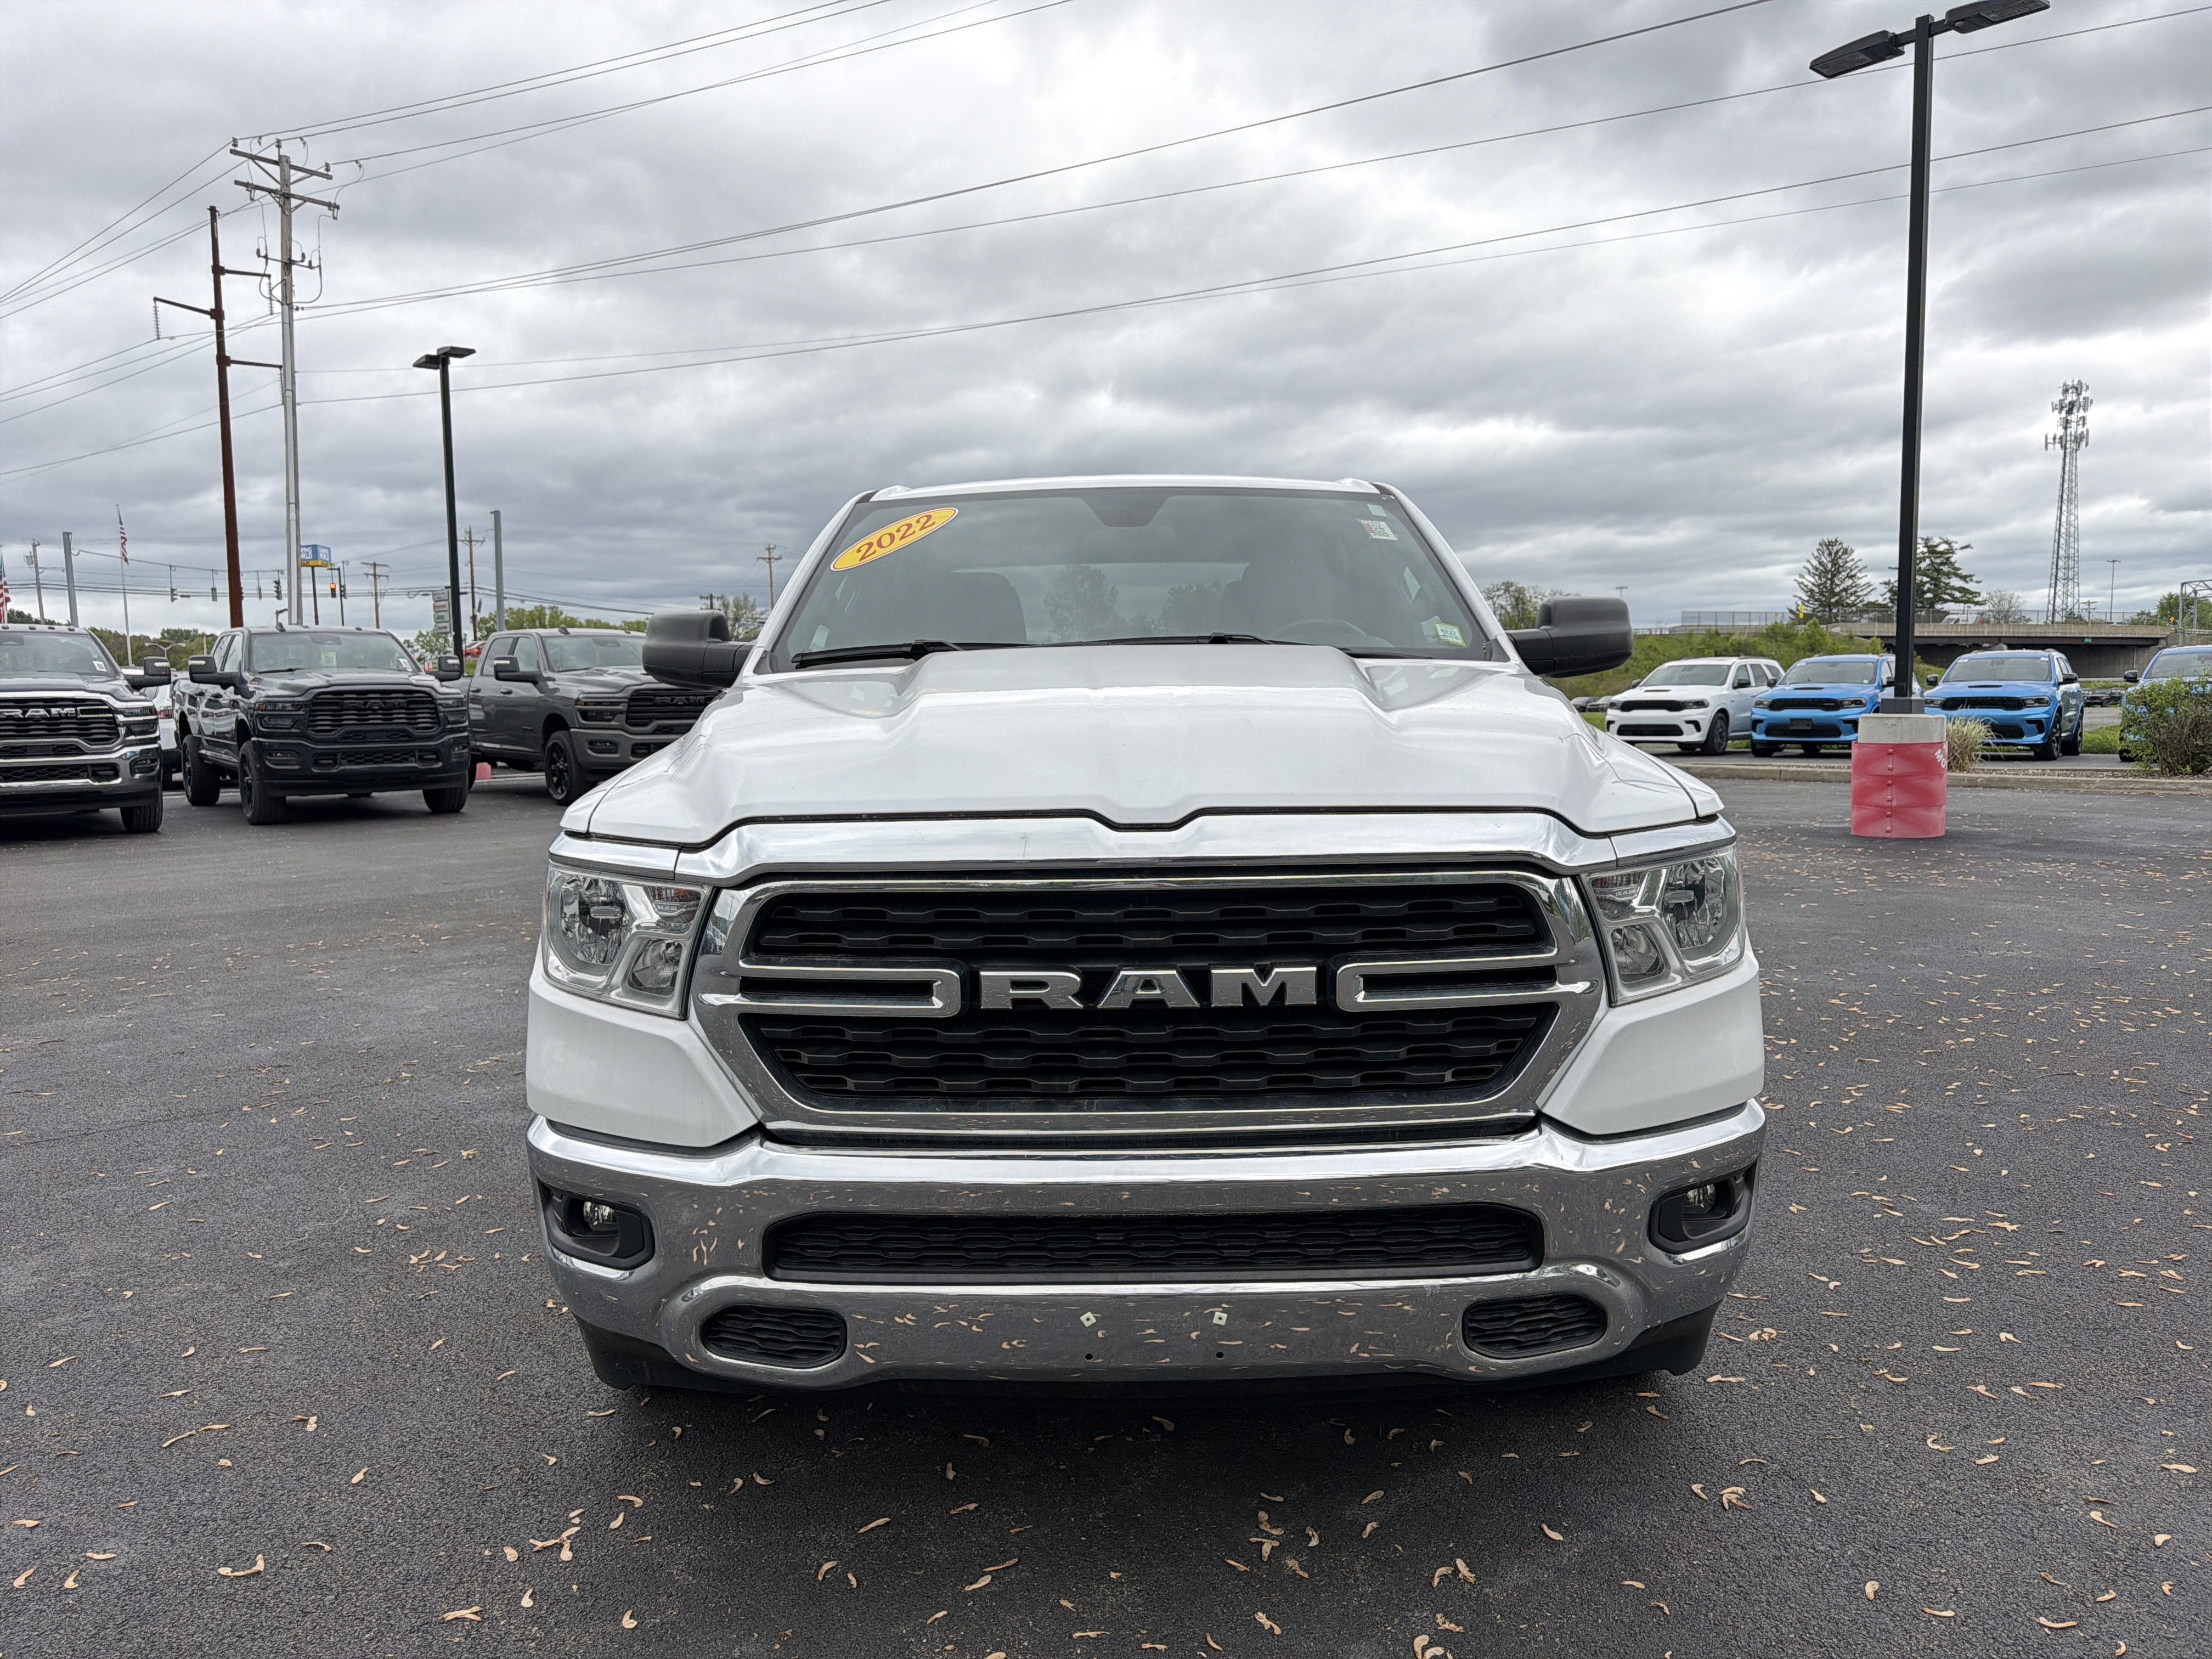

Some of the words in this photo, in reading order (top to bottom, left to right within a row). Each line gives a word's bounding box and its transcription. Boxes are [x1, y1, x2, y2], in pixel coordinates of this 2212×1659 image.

[856, 514, 936, 562] 2022
[343, 699, 407, 709] RAM
[655, 696, 705, 704] RAM
[0, 708, 76, 718] RAM
[979, 967, 1318, 1008] RAM
